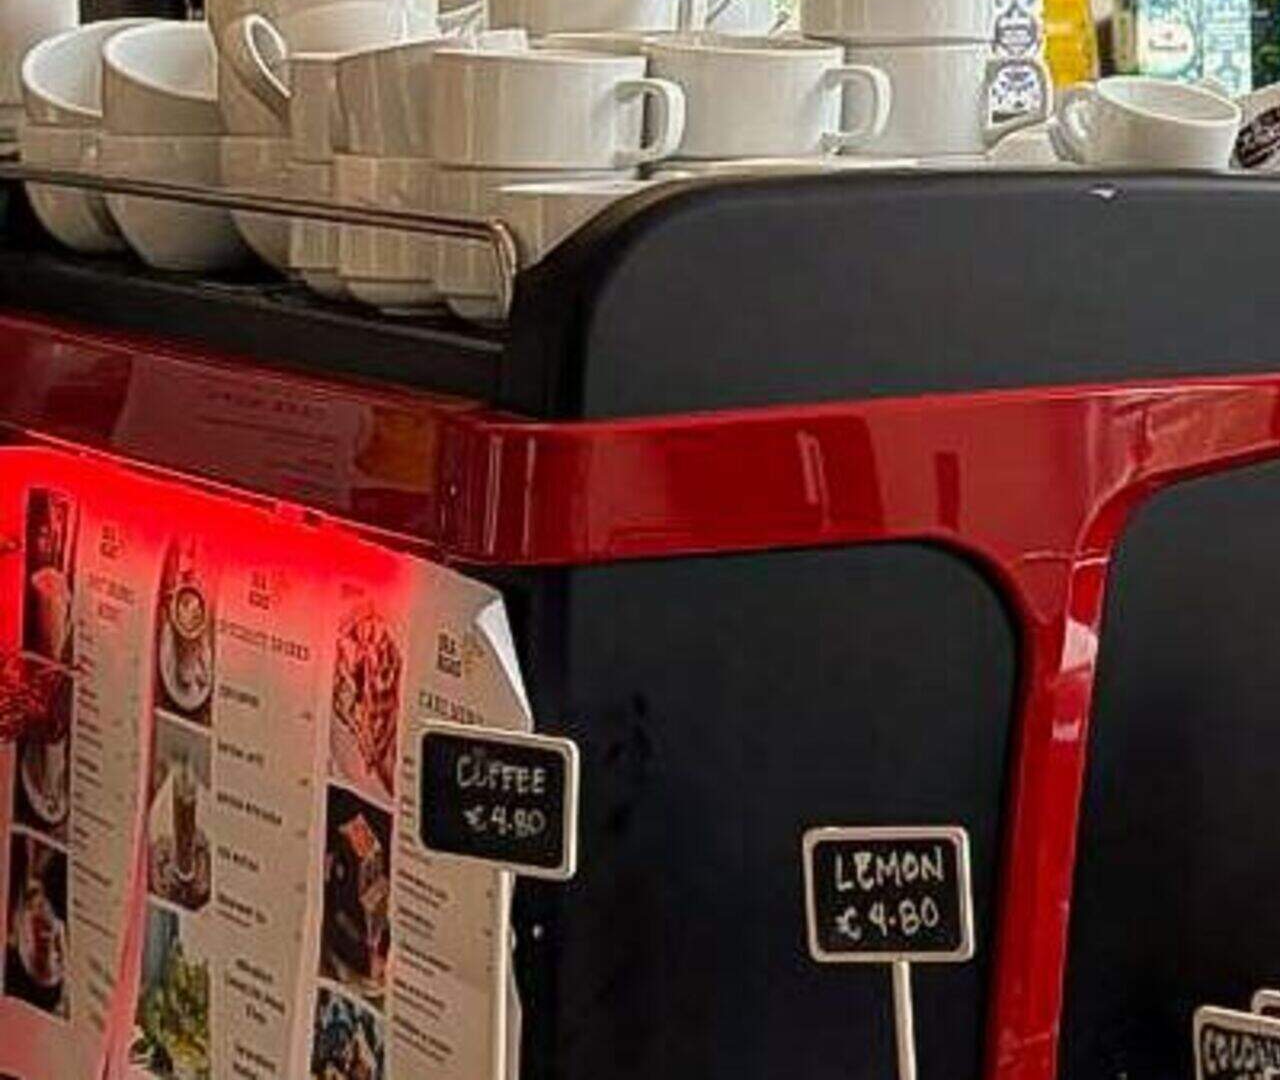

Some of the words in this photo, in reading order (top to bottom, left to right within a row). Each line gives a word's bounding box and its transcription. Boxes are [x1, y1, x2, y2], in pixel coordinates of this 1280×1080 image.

[457, 753, 547, 796] COFFEE
[834, 845, 945, 894] LEMON
[834, 895, 940, 941] €4.80
